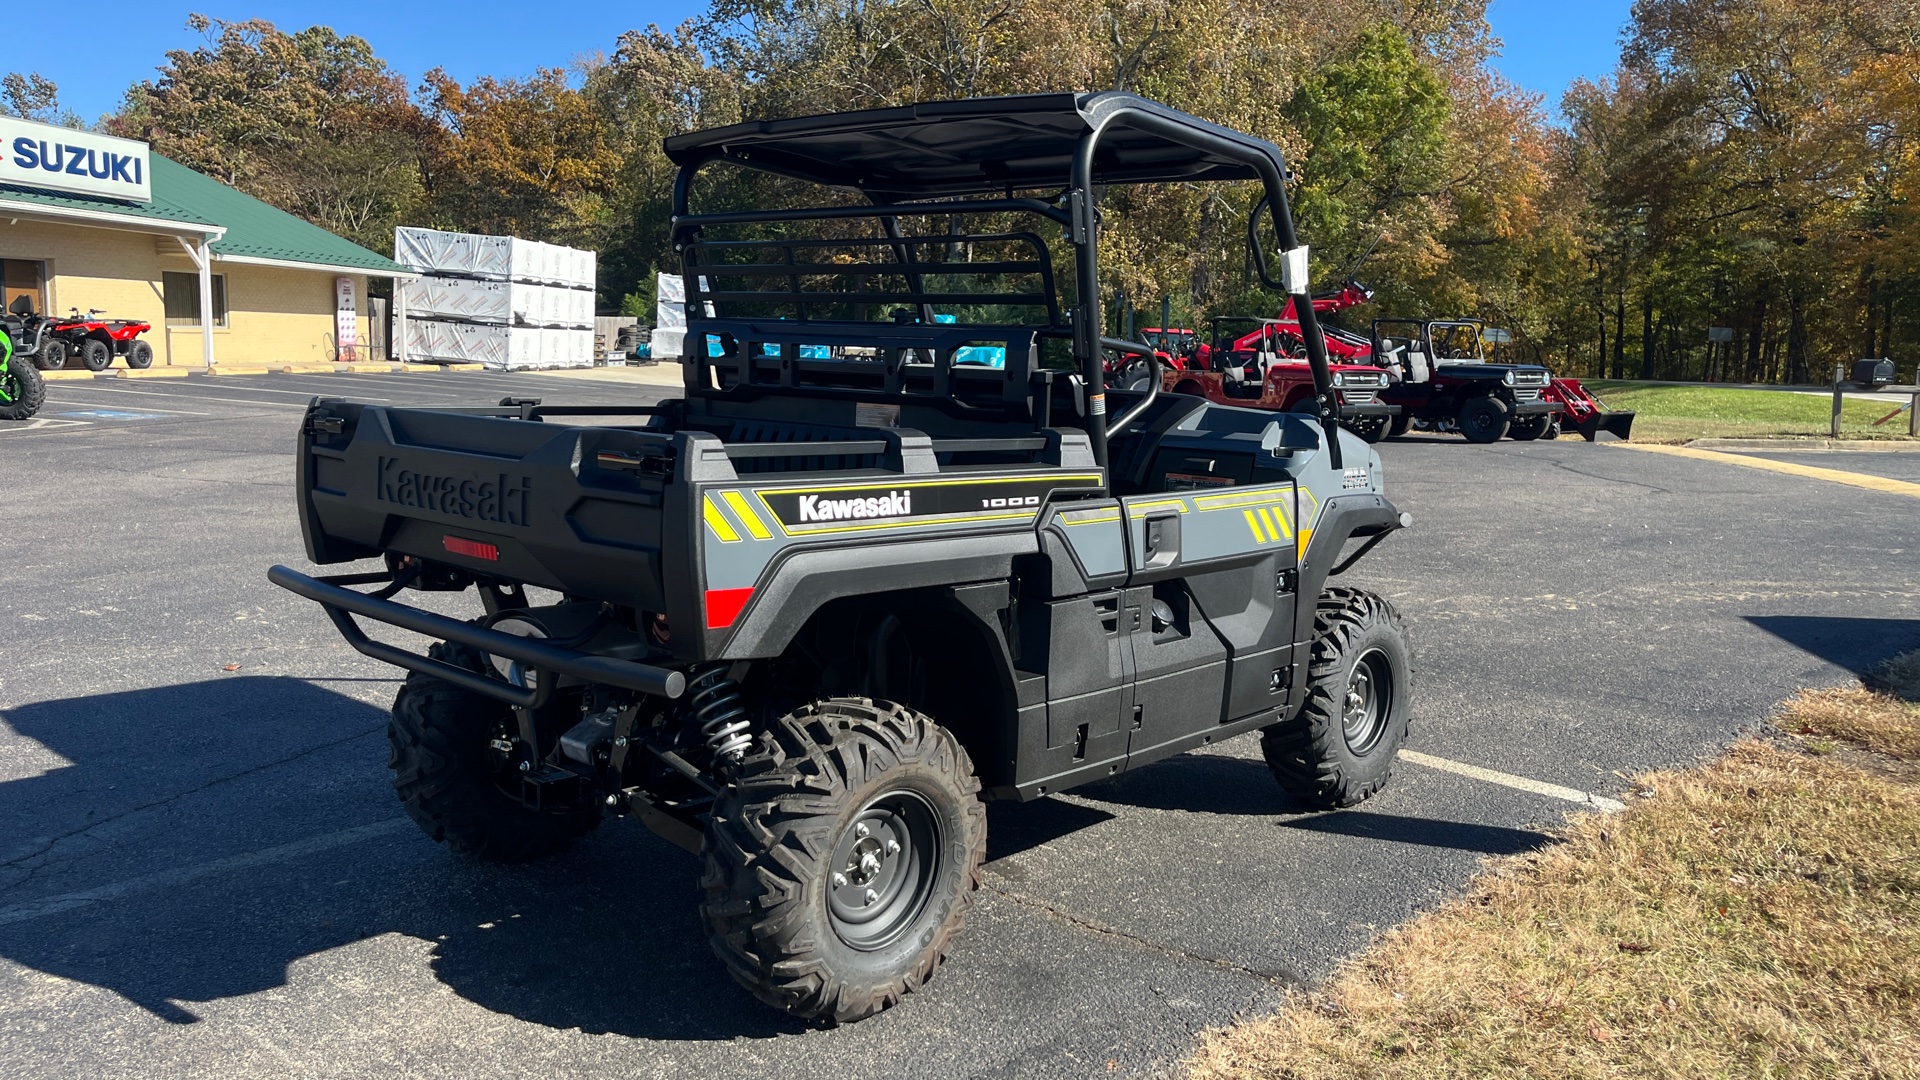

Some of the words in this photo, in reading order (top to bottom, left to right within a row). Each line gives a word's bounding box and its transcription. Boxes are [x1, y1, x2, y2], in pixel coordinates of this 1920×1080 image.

[13, 136, 143, 185] SUZUKI
[377, 455, 532, 527] Kawasaki
[799, 490, 911, 521] Kawasaki
[981, 496, 1040, 508] 1000
